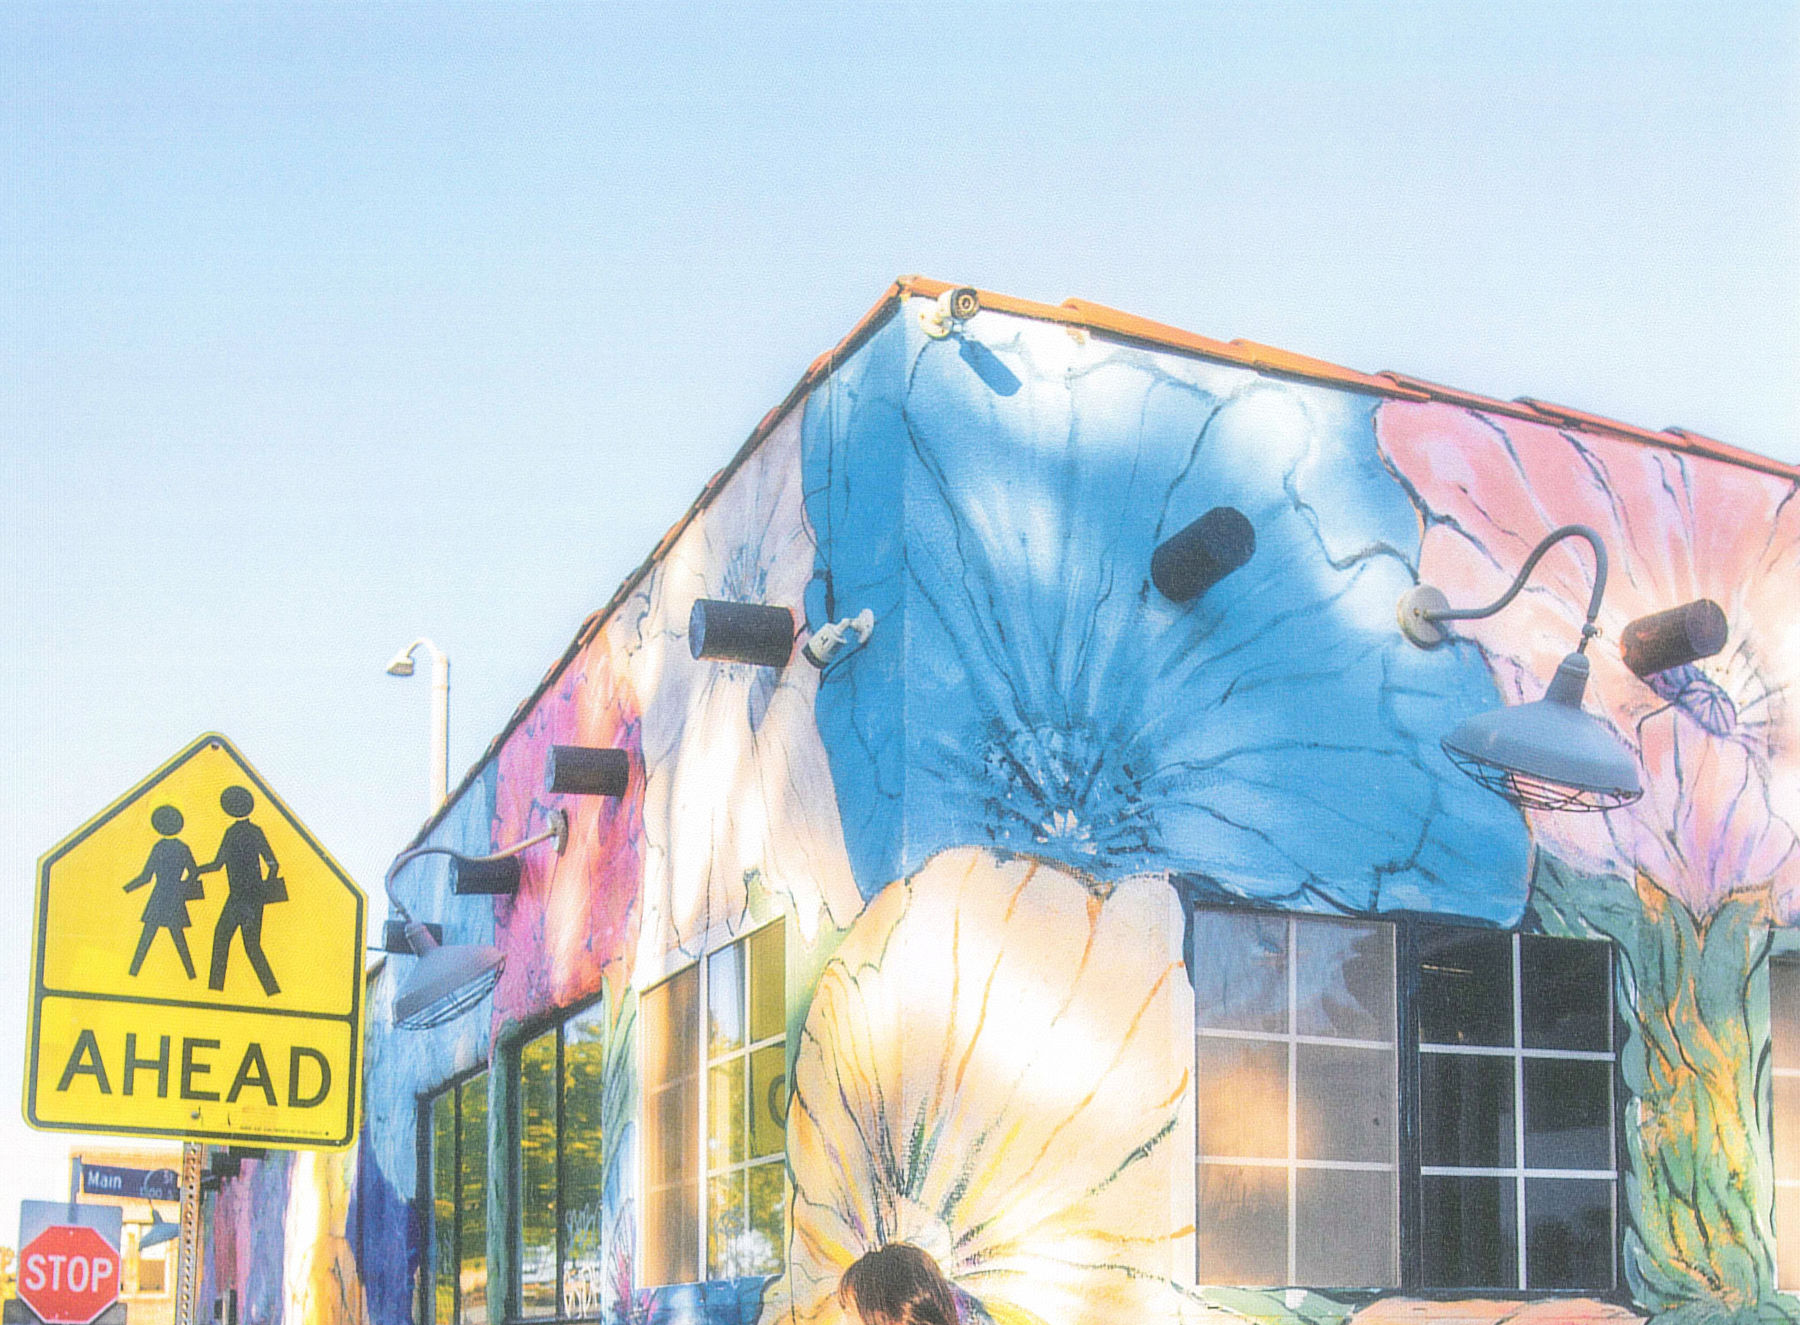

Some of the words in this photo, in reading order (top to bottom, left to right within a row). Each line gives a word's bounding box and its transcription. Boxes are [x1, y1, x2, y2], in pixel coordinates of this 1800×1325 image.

[56, 1029, 332, 1108] AHEAD
[88, 1170, 122, 1189] Main
[25, 1254, 113, 1293] STOP
